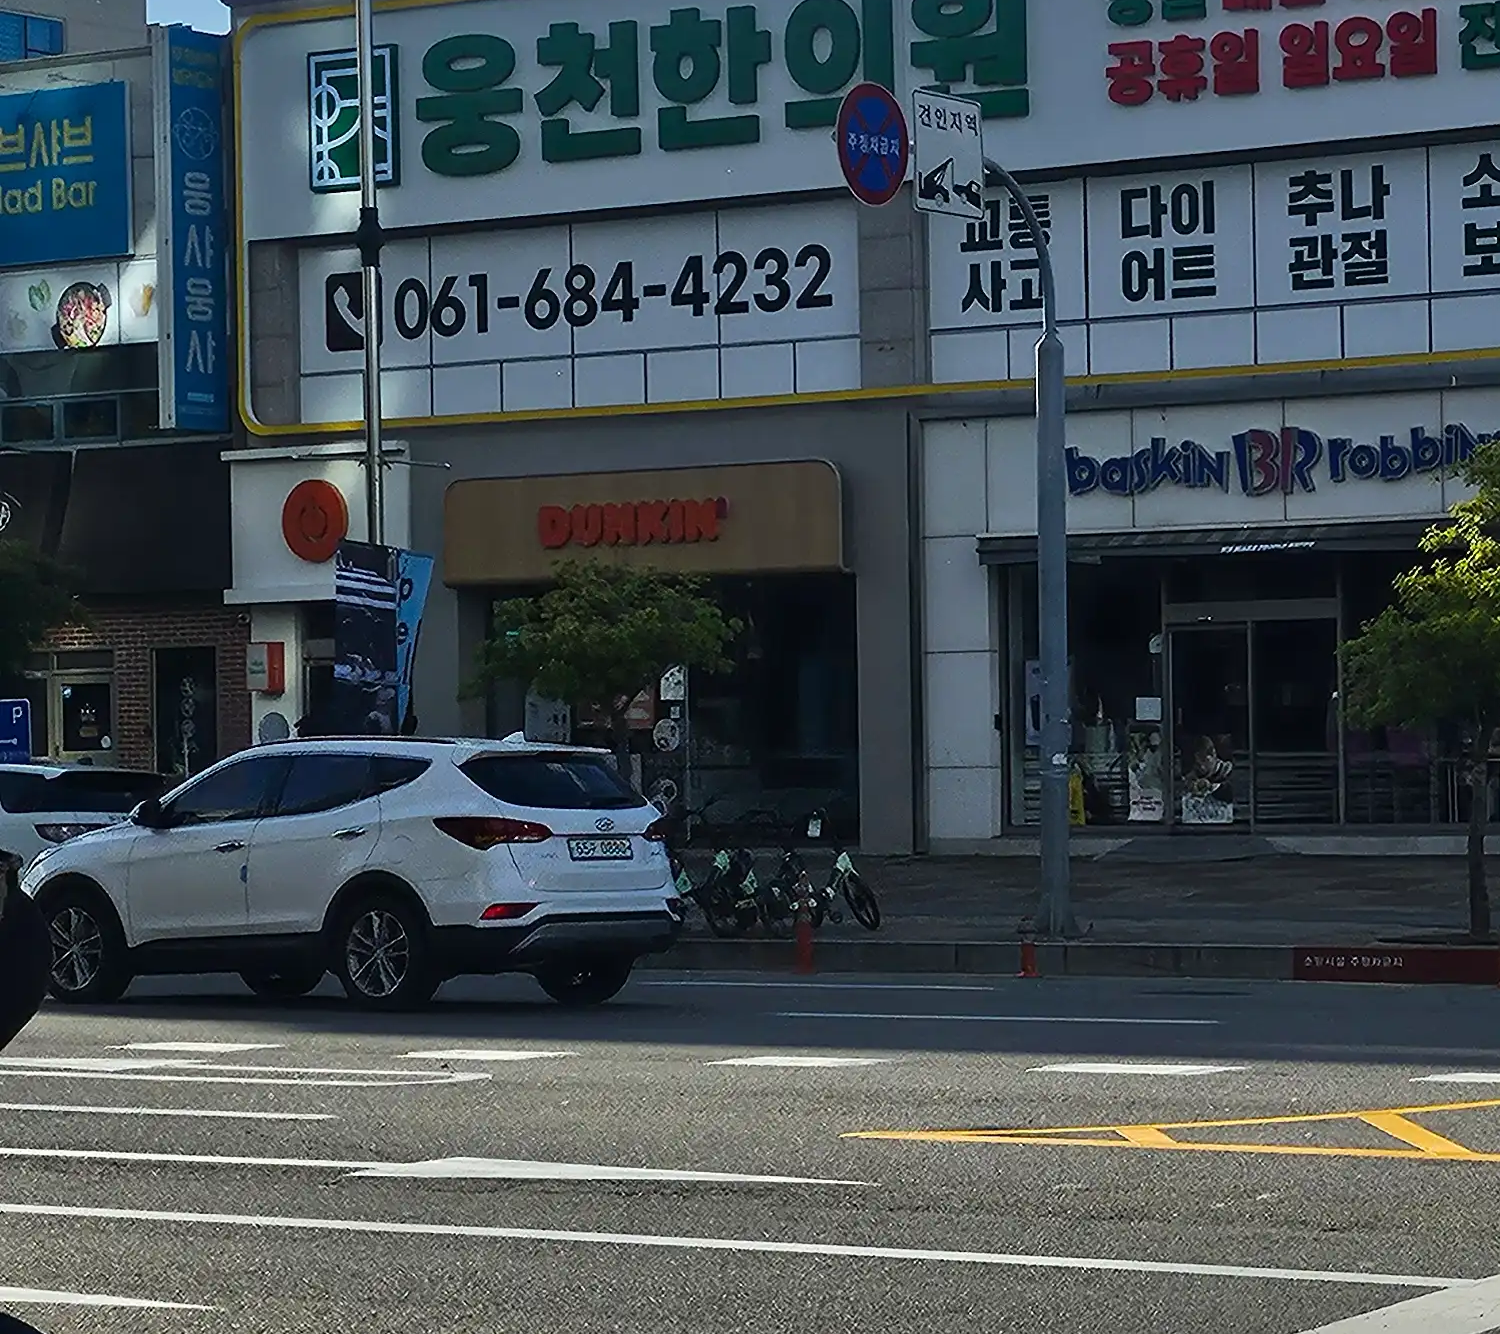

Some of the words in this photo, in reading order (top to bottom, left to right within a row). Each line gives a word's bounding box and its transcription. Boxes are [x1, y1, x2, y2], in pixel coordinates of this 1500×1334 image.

[1106, 28, 1260, 105] 공휴일
[1279, 7, 1438, 89] 일요일
[918, 104, 979, 137] 견인지역
[52, 178, 97, 211] Bar
[960, 194, 1051, 253] 교통
[1120, 179, 1216, 240] 다이
[1287, 165, 1389, 224] 추나
[961, 259, 1044, 313] 사고
[1121, 244, 1217, 302] 어트
[1288, 228, 1388, 291] 관절
[394, 243, 833, 340] 061-684-4232
[1064, 436, 1230, 497] baskin
[1231, 426, 1323, 497] BR
[13, 706, 23, 724] P
